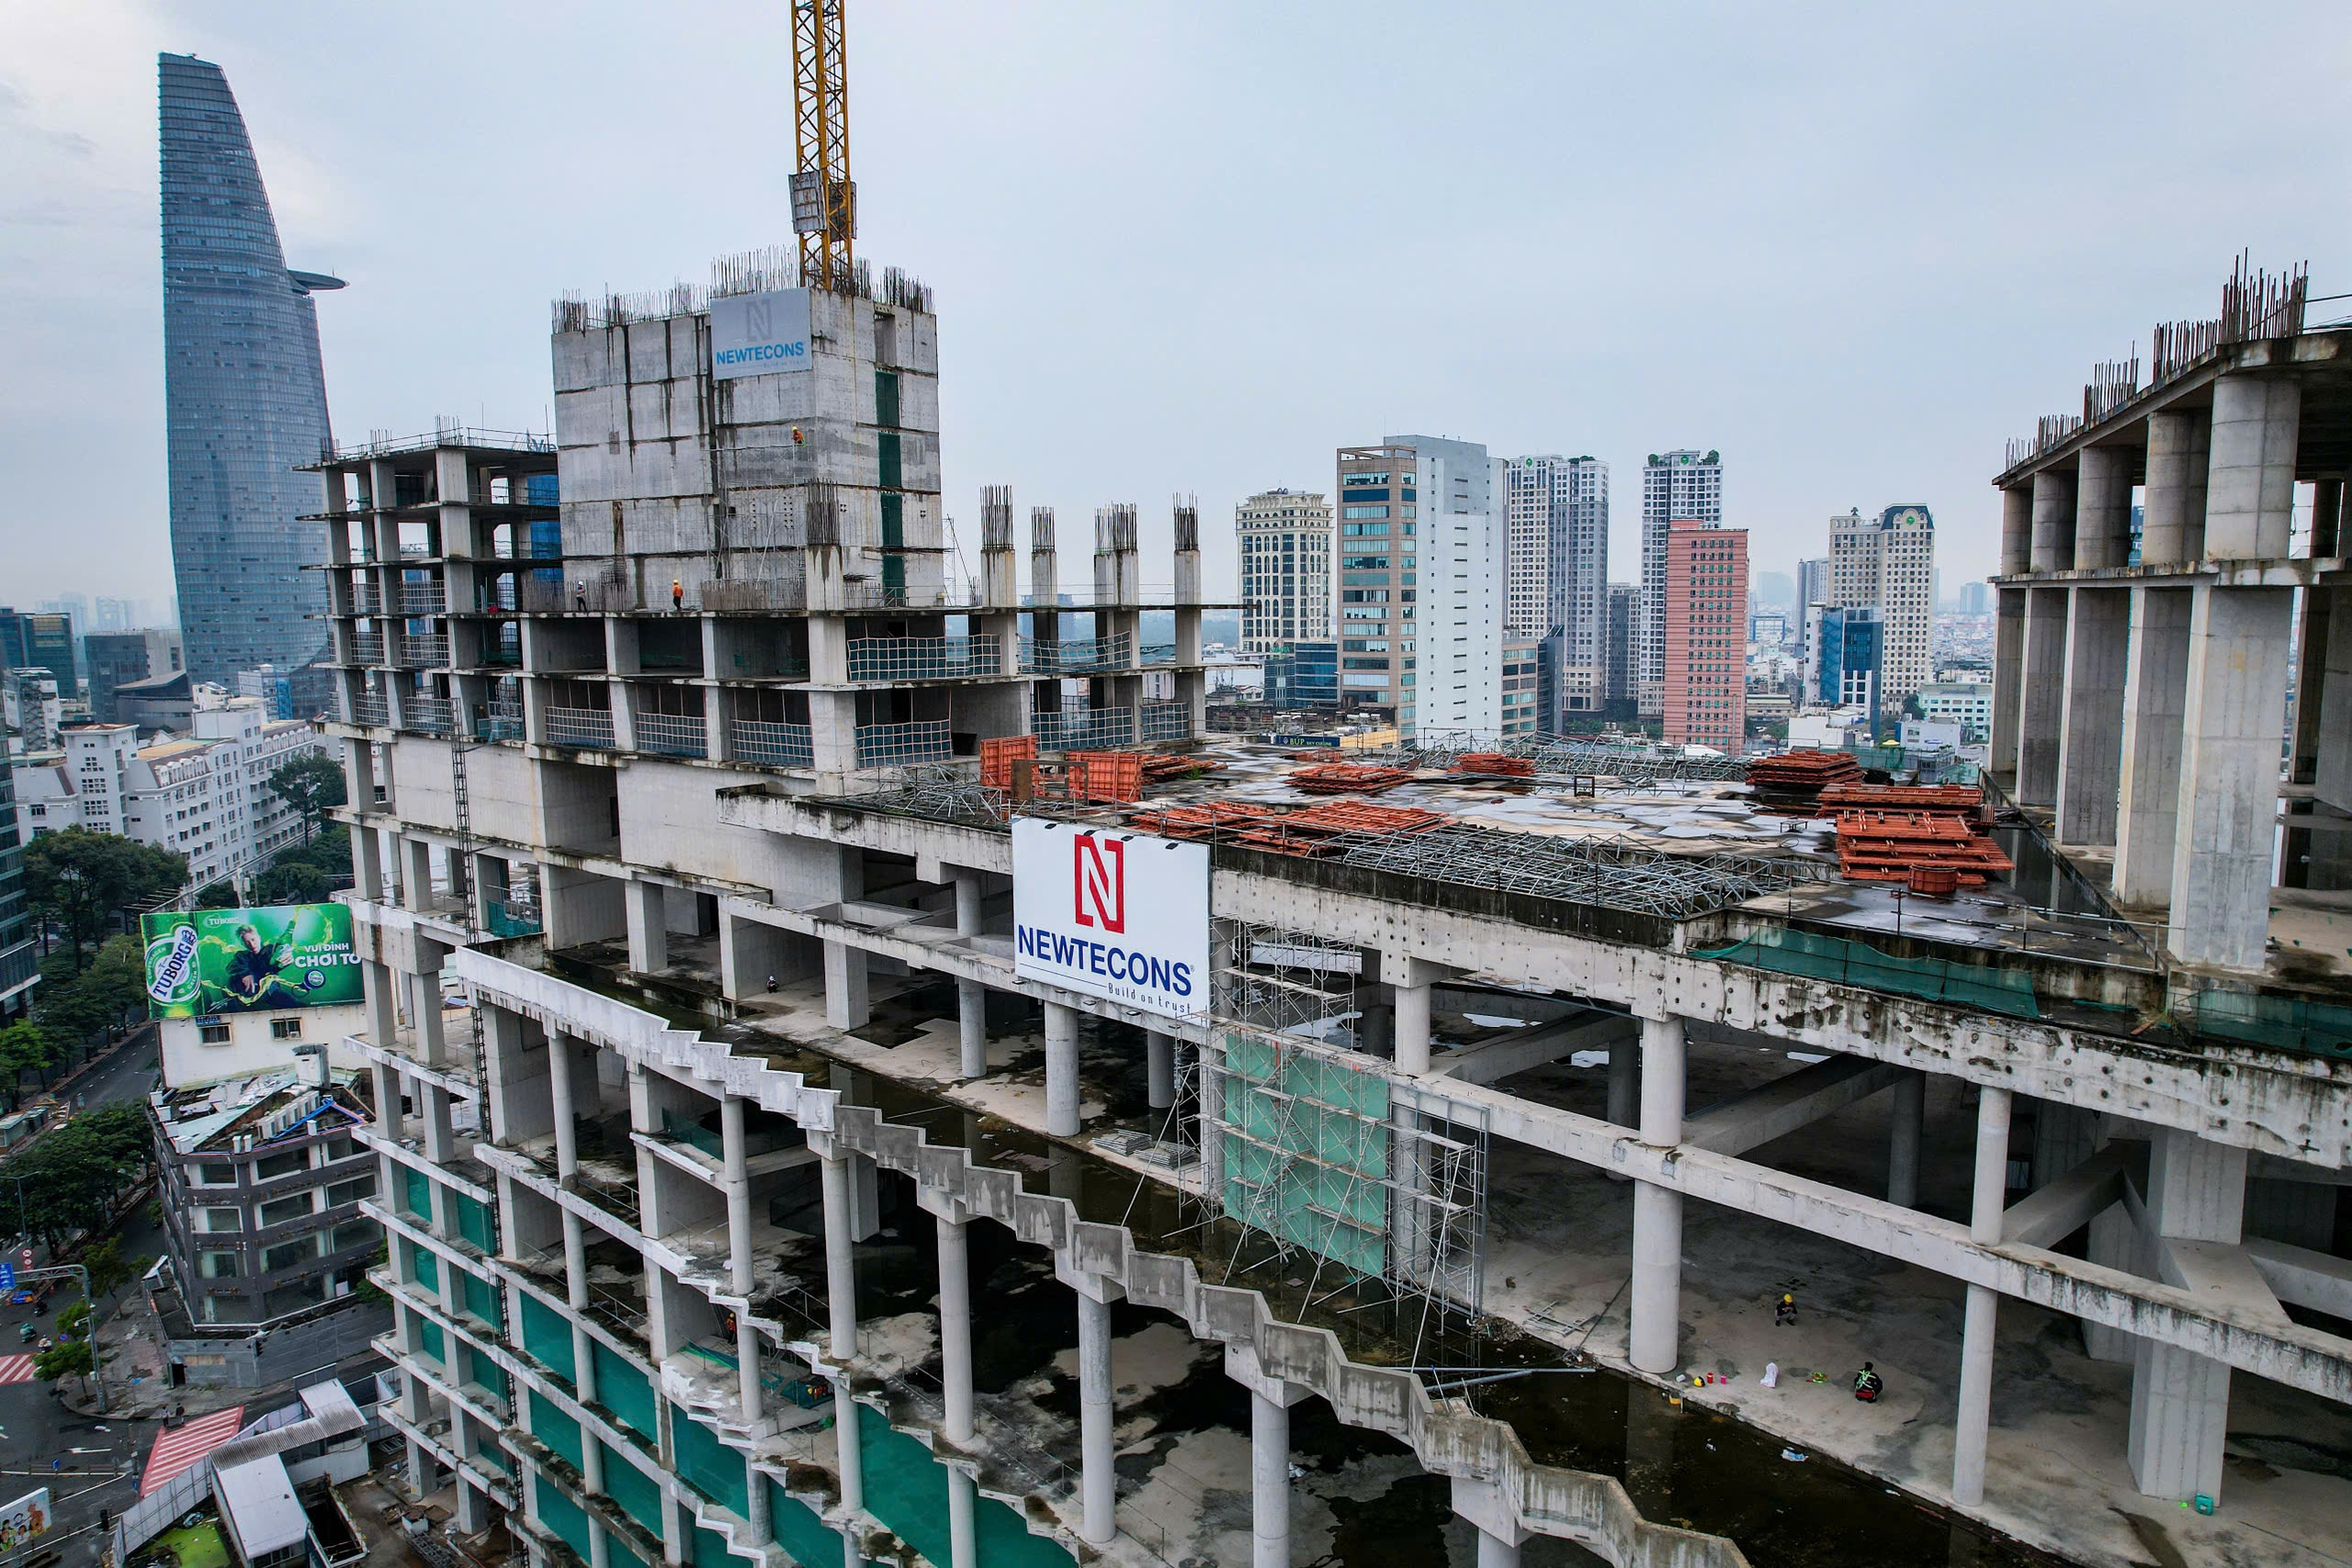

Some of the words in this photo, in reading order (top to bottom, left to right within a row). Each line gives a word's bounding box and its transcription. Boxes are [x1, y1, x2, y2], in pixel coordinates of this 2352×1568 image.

[717, 341, 805, 366] NEWTECONS
[1289, 736, 1305, 746] BÚP
[1074, 833, 1125, 934] N
[304, 943, 322, 953] VUI
[340, 953, 362, 964] TO
[1018, 924, 1192, 997] NEWTECONS
[153, 942, 193, 997] TUBORG
[1108, 982, 1136, 1000] Build
[1140, 994, 1153, 1005] on
[1158, 995, 1191, 1014] trust
